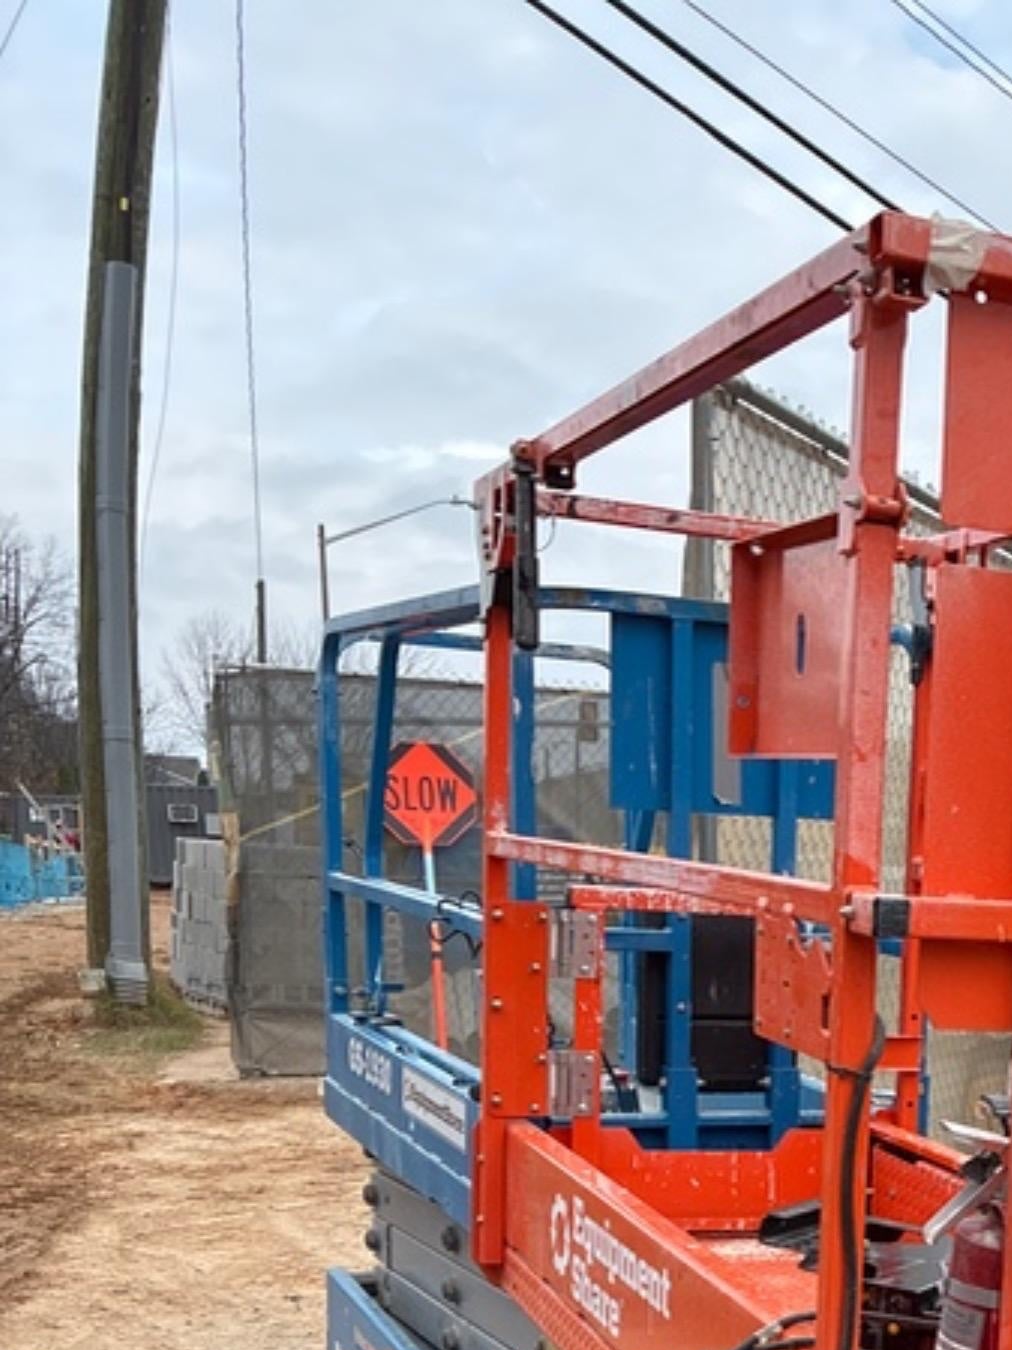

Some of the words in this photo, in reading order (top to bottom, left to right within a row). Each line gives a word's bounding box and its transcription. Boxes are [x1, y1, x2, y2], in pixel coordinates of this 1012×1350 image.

[384, 775, 457, 812] SLOW
[572, 1195, 671, 1320] Equipment
[572, 1254, 621, 1338] Share
